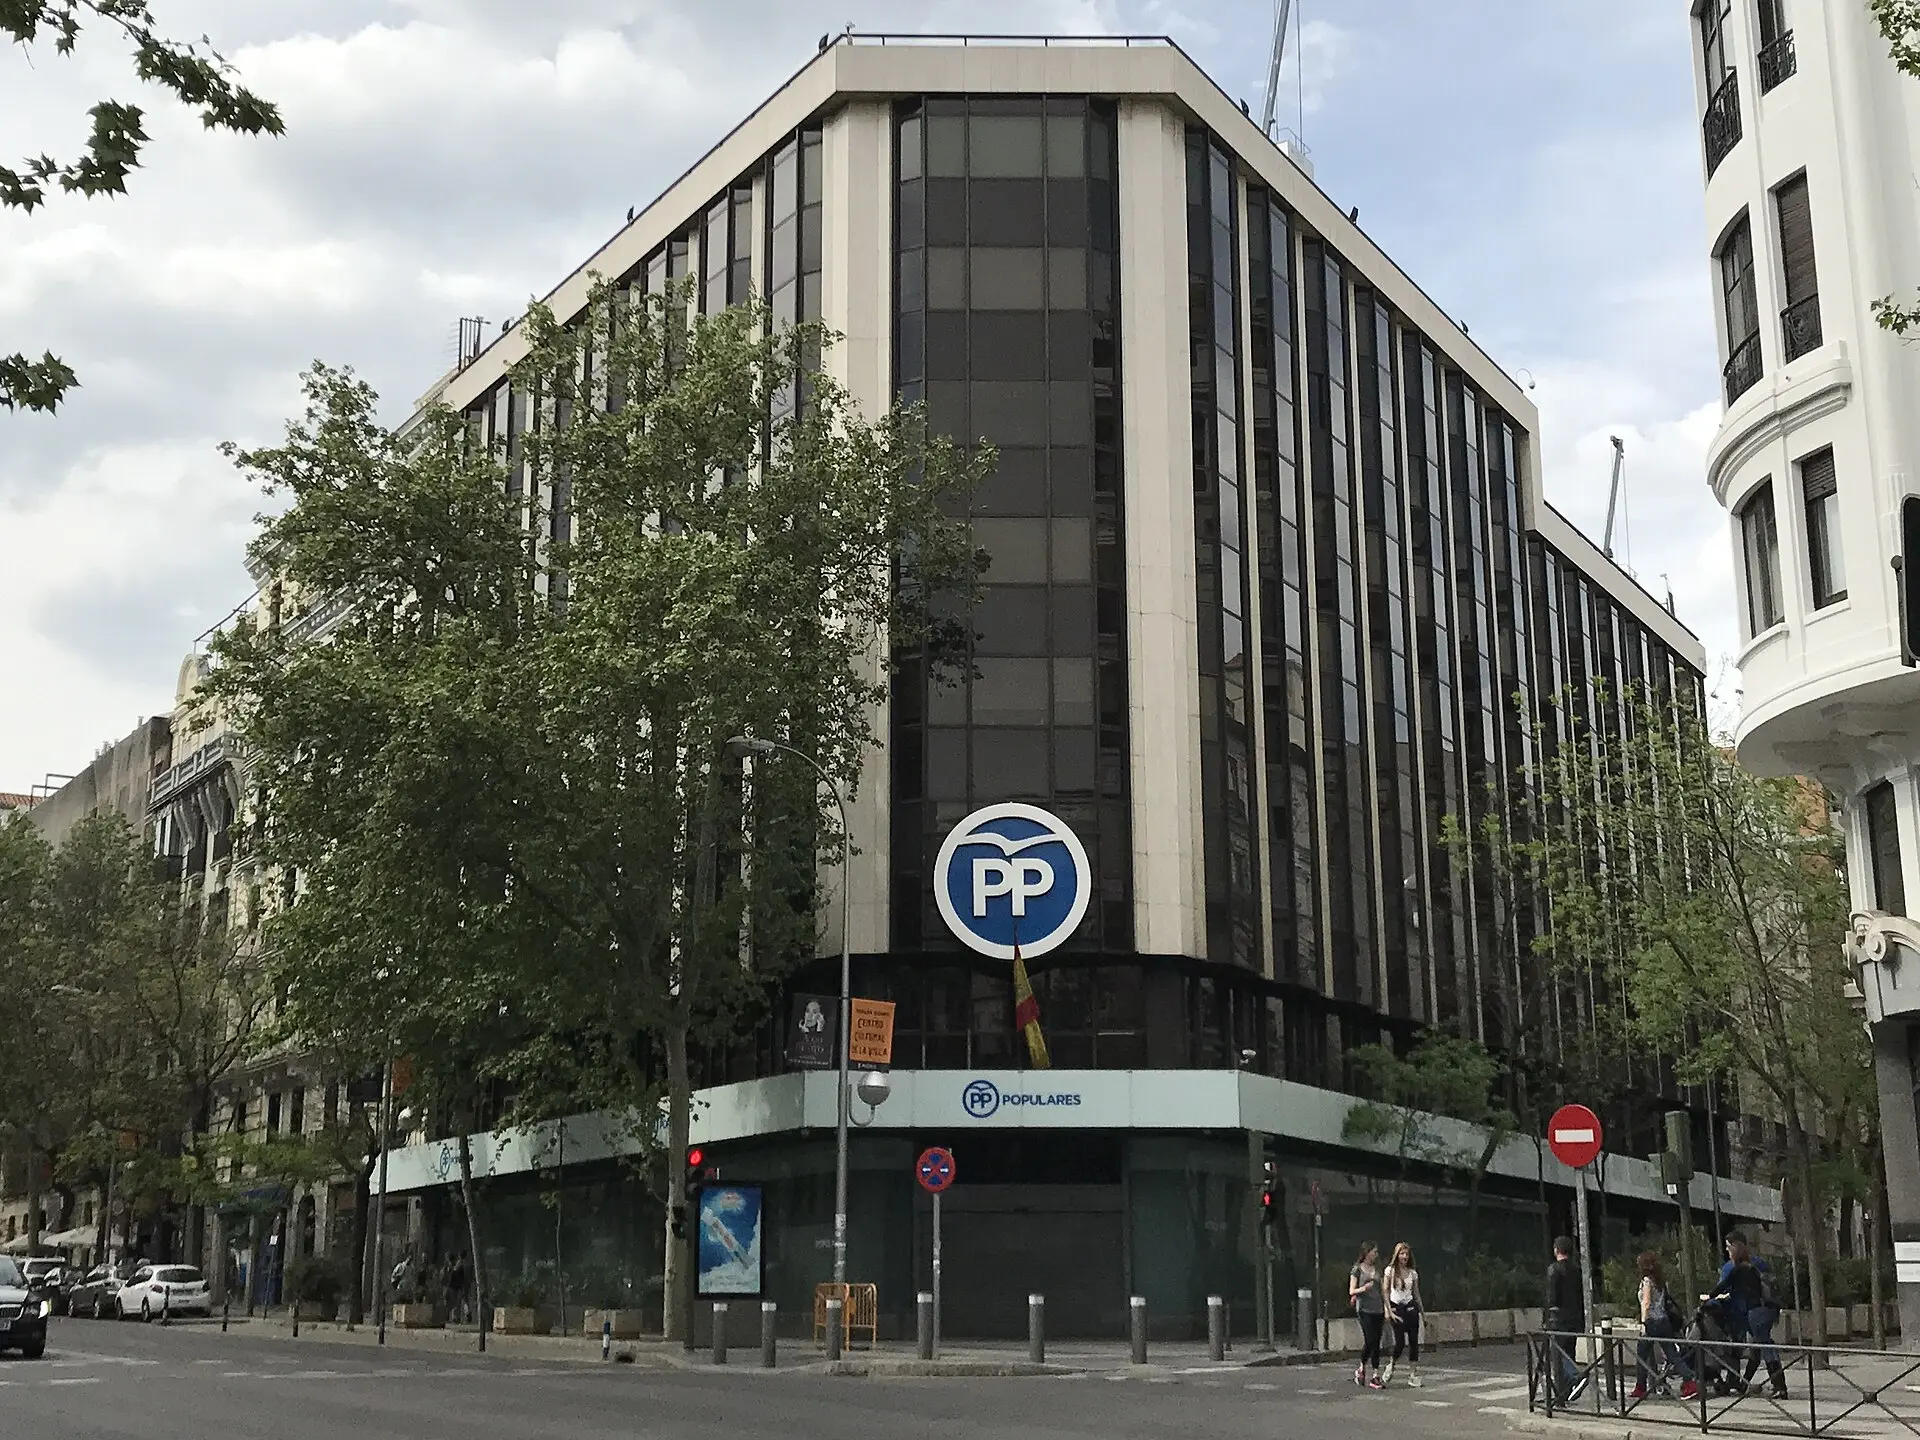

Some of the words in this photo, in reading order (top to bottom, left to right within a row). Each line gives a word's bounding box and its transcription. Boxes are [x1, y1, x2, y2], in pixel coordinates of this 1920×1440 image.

[973, 858, 1055, 917] PP
[970, 1092, 992, 1109] PP
[1002, 1094, 1082, 1106] POPULARES
